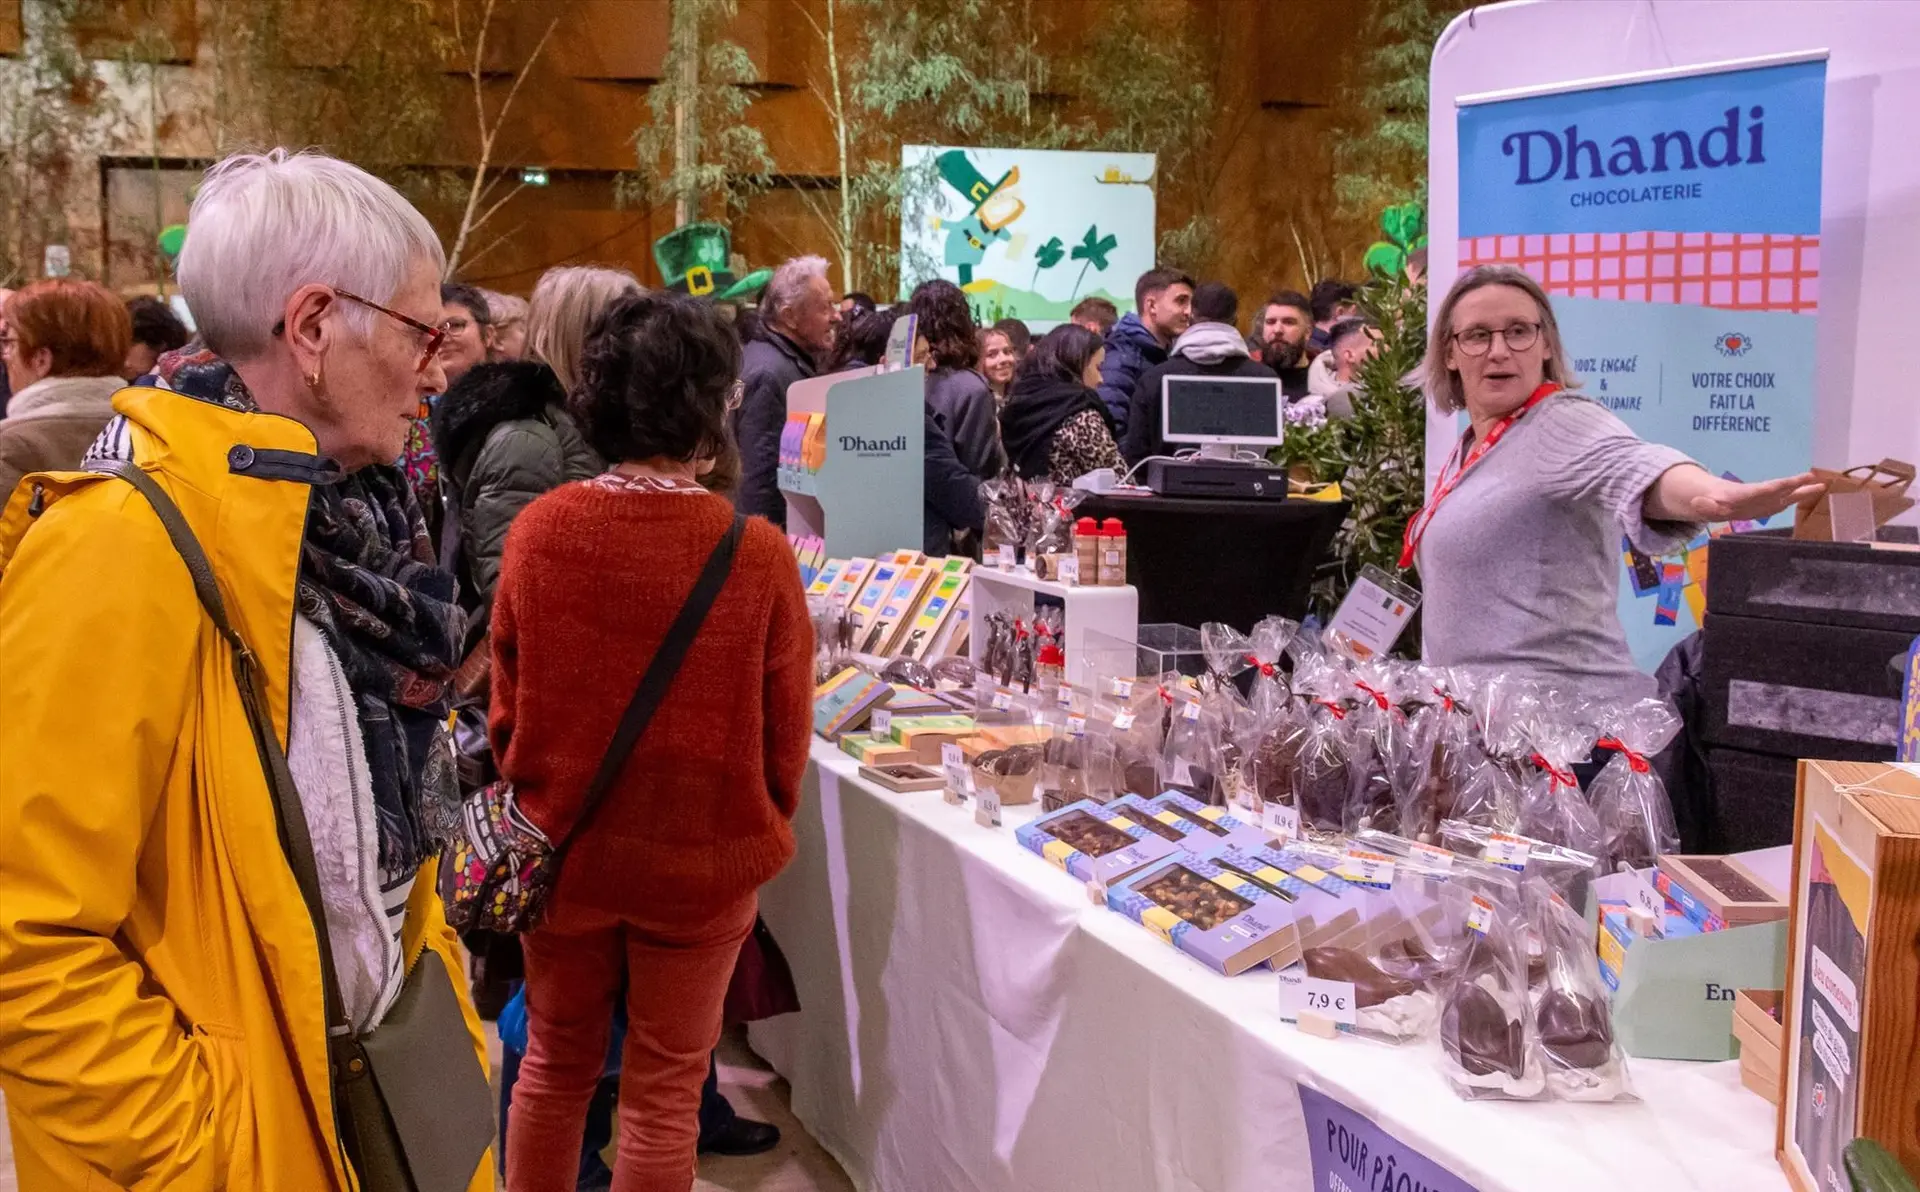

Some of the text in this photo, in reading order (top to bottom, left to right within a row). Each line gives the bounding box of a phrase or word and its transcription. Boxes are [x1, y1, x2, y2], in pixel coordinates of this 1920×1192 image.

[1502, 105, 1766, 185] Dhandi
[1570, 183, 1703, 207] CHOCOLATERIE
[1600, 355, 1638, 372] ENGAGÉ
[1599, 378, 1608, 391] &
[1692, 372, 1775, 388] VOTRE CHOIX
[1710, 394, 1755, 410] FAIT LA
[1692, 412, 1771, 432] DIFFÉRENCE
[839, 435, 907, 451] Dhandi
[1307, 991, 1346, 1011] 7,9 €
[1327, 1117, 1368, 1181] POUR
